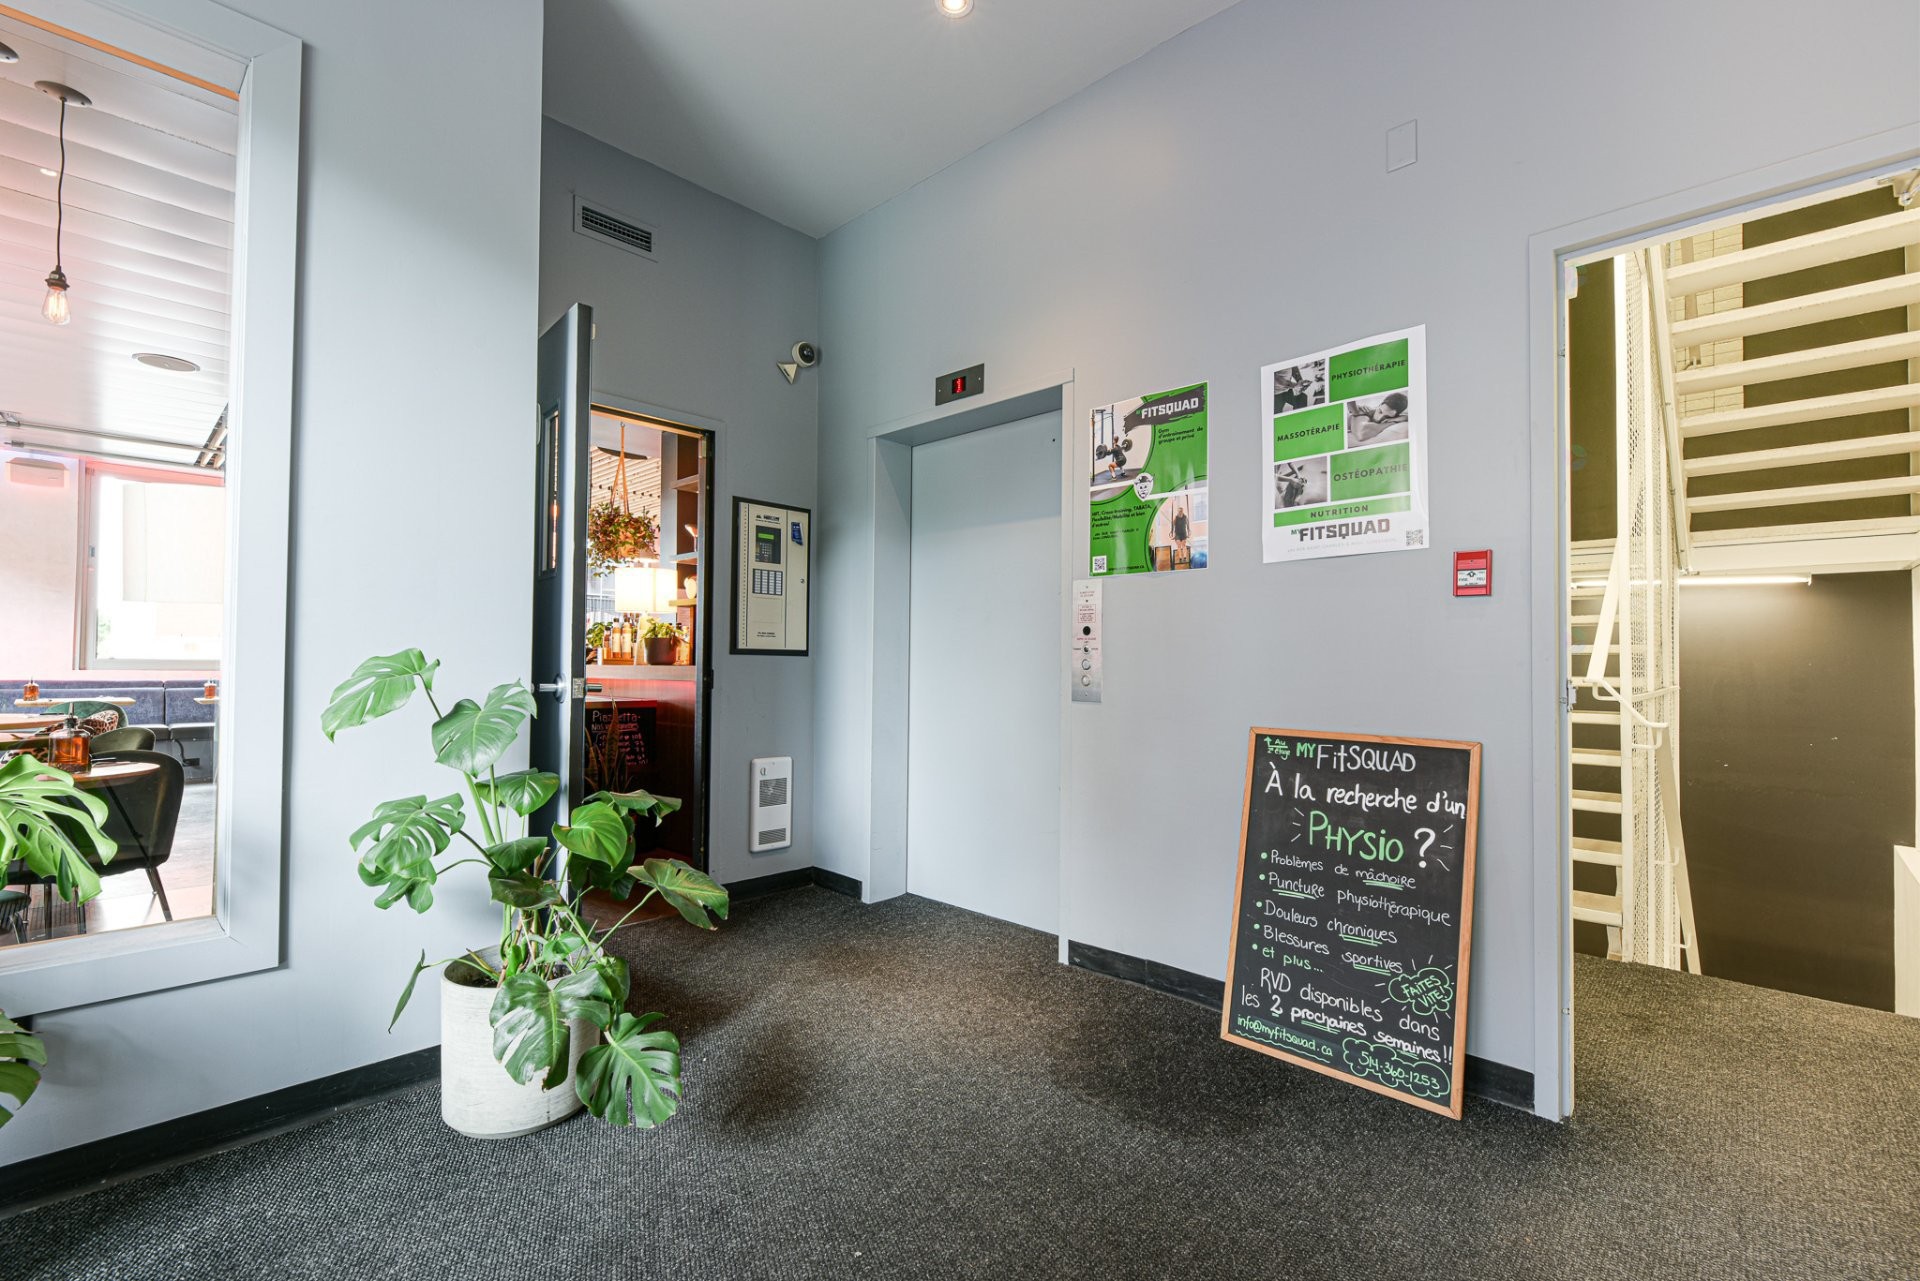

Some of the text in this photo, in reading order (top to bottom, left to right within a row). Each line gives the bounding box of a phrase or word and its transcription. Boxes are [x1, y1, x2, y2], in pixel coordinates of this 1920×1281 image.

[1331, 360, 1406, 382] PHYSIOTHÉRAPIE
[956, 378, 962, 393] 1
[1141, 398, 1199, 419] FITSQUAD
[1277, 423, 1340, 442] MASSOTÉRAPIE
[1334, 463, 1408, 482] OSTÉOPATHIE
[1310, 505, 1369, 518] NUTRITION
[1265, 762, 1466, 819] À la recherche d'un
[1414, 827, 1436, 869] ?
[1271, 850, 1324, 871] Problèmes
[1335, 864, 1349, 876] de
[1264, 900, 1398, 944] Douleurs chroniques
[1262, 946, 1275, 958] et
[1263, 925, 1403, 974] Blessures sportives
[1241, 985, 1260, 1008] les
[1270, 995, 1283, 1014] 2
[1291, 1007, 1367, 1036] prochaines
[1260, 968, 1440, 1041] RVD disponibles dans
